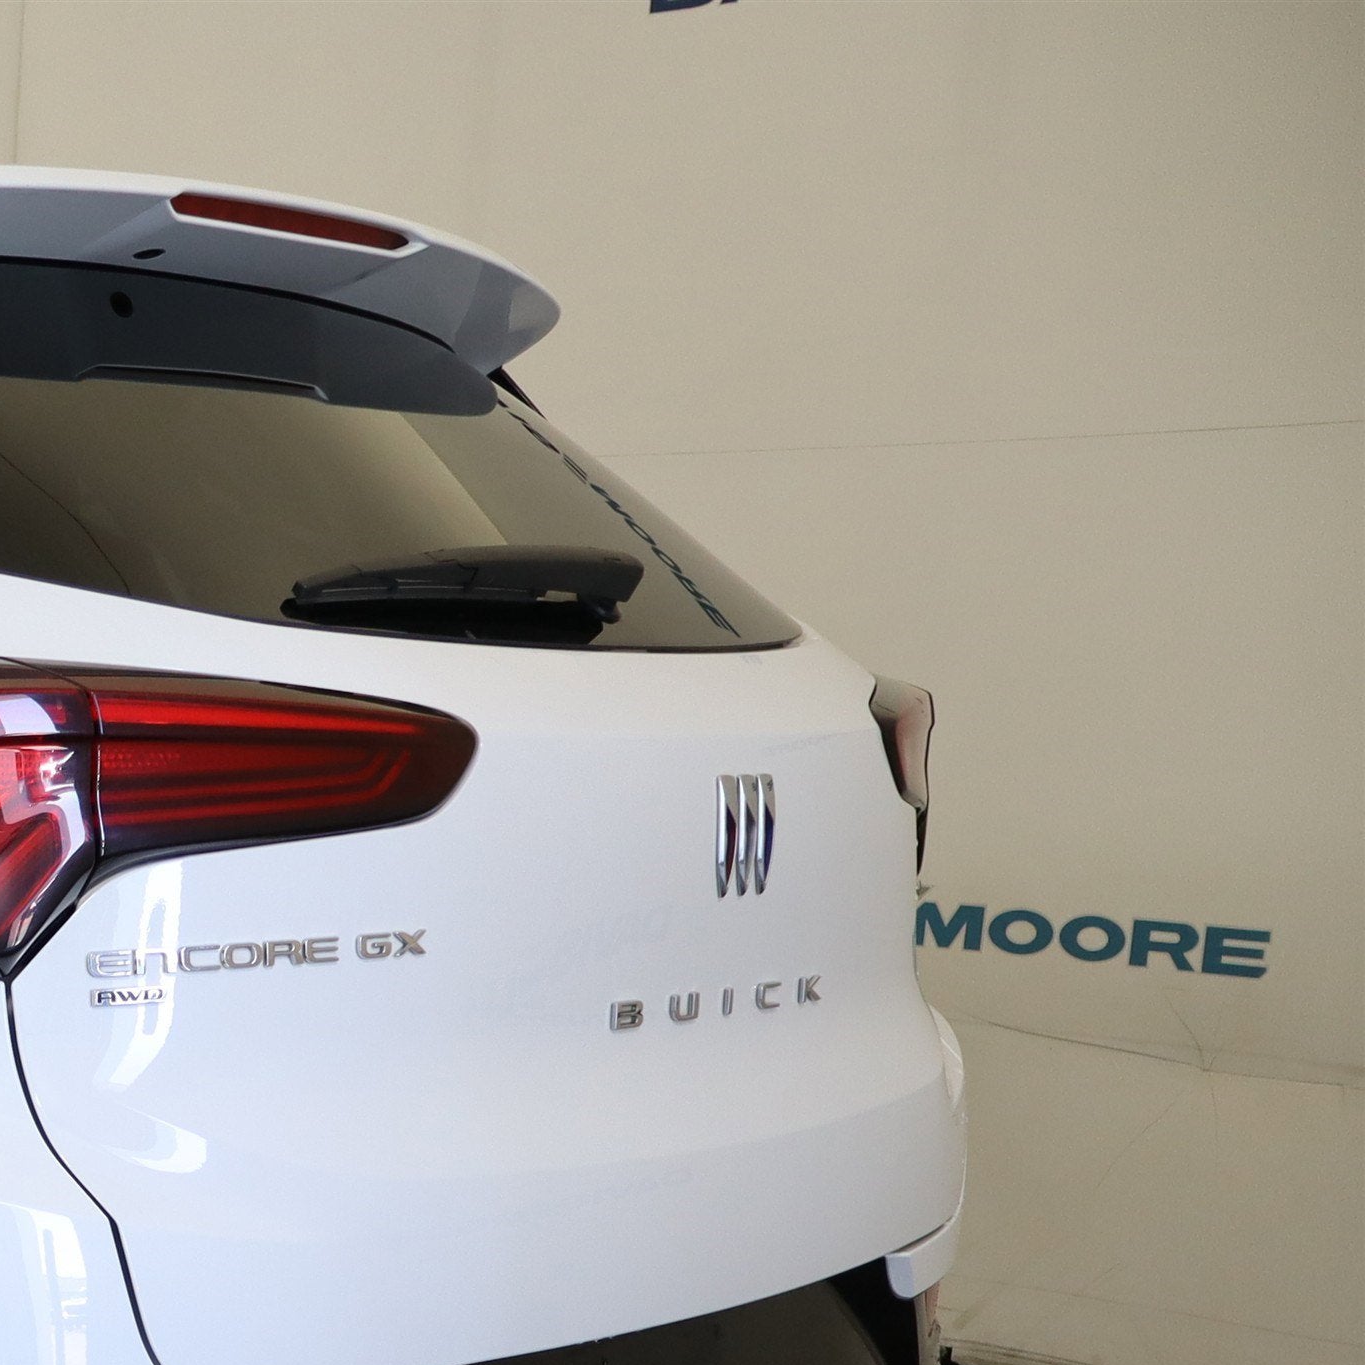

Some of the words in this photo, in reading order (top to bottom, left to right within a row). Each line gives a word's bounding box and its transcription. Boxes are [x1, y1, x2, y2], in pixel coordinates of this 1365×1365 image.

[86, 936, 340, 978] ENCORE
[355, 929, 427, 960] GX
[915, 902, 1271, 979] MOORE
[93, 987, 167, 1007] AWD
[609, 974, 822, 1032] BUICK
